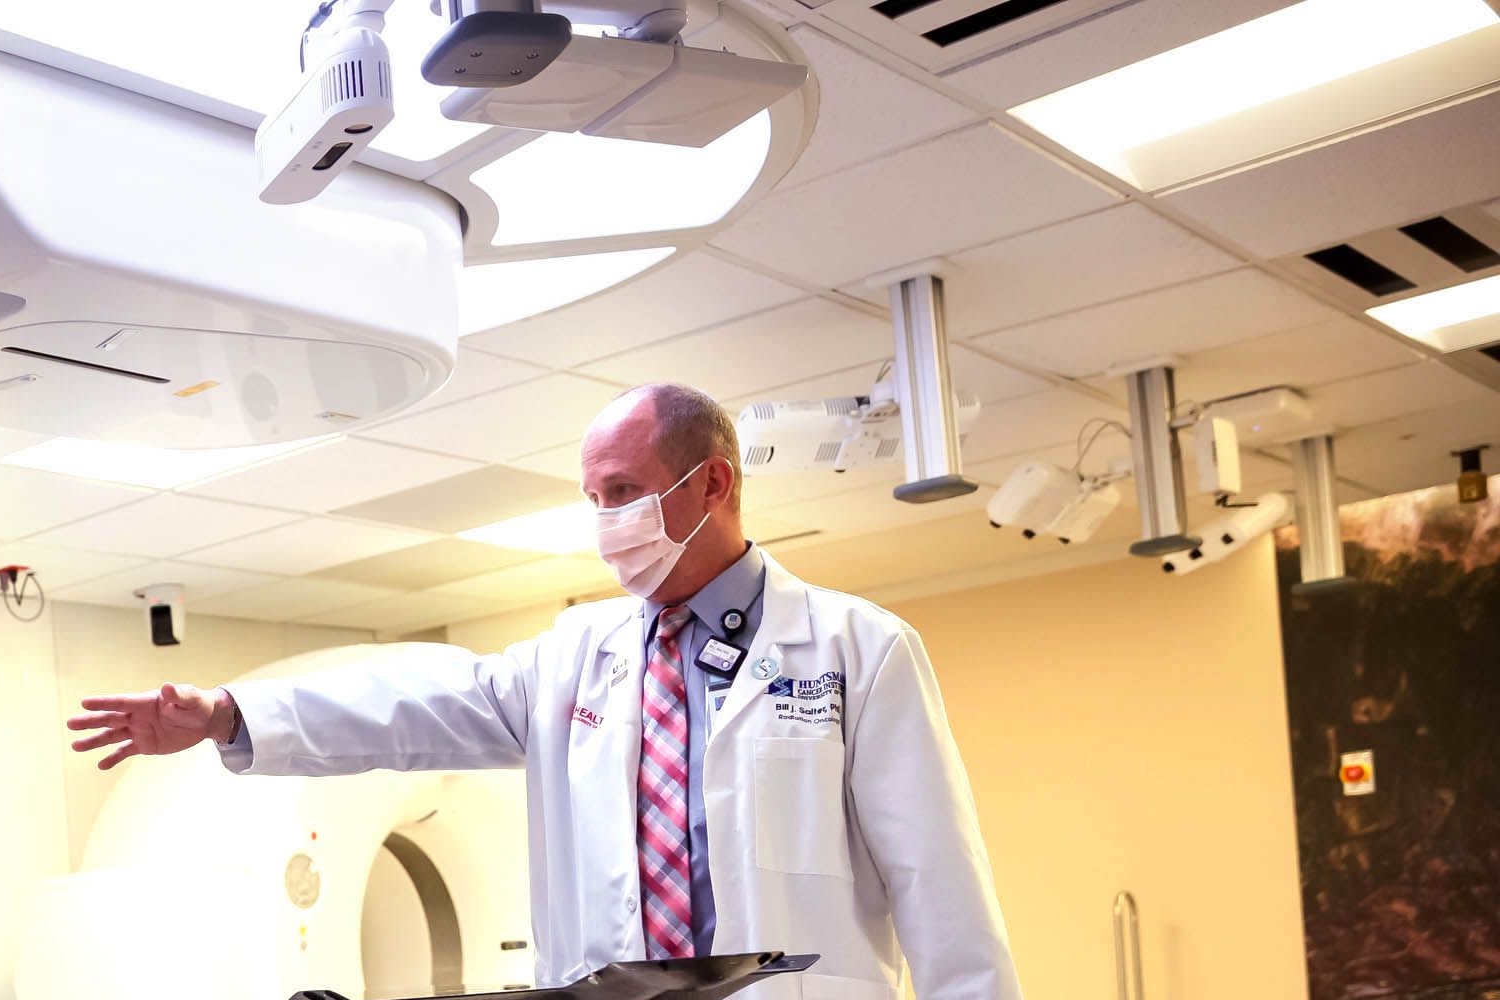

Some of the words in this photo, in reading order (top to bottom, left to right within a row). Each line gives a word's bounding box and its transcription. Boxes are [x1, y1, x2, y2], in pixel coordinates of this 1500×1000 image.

[790, 704, 797, 713] J.
[799, 706, 828, 715] Salter,
[779, 714, 811, 723] Radiation
